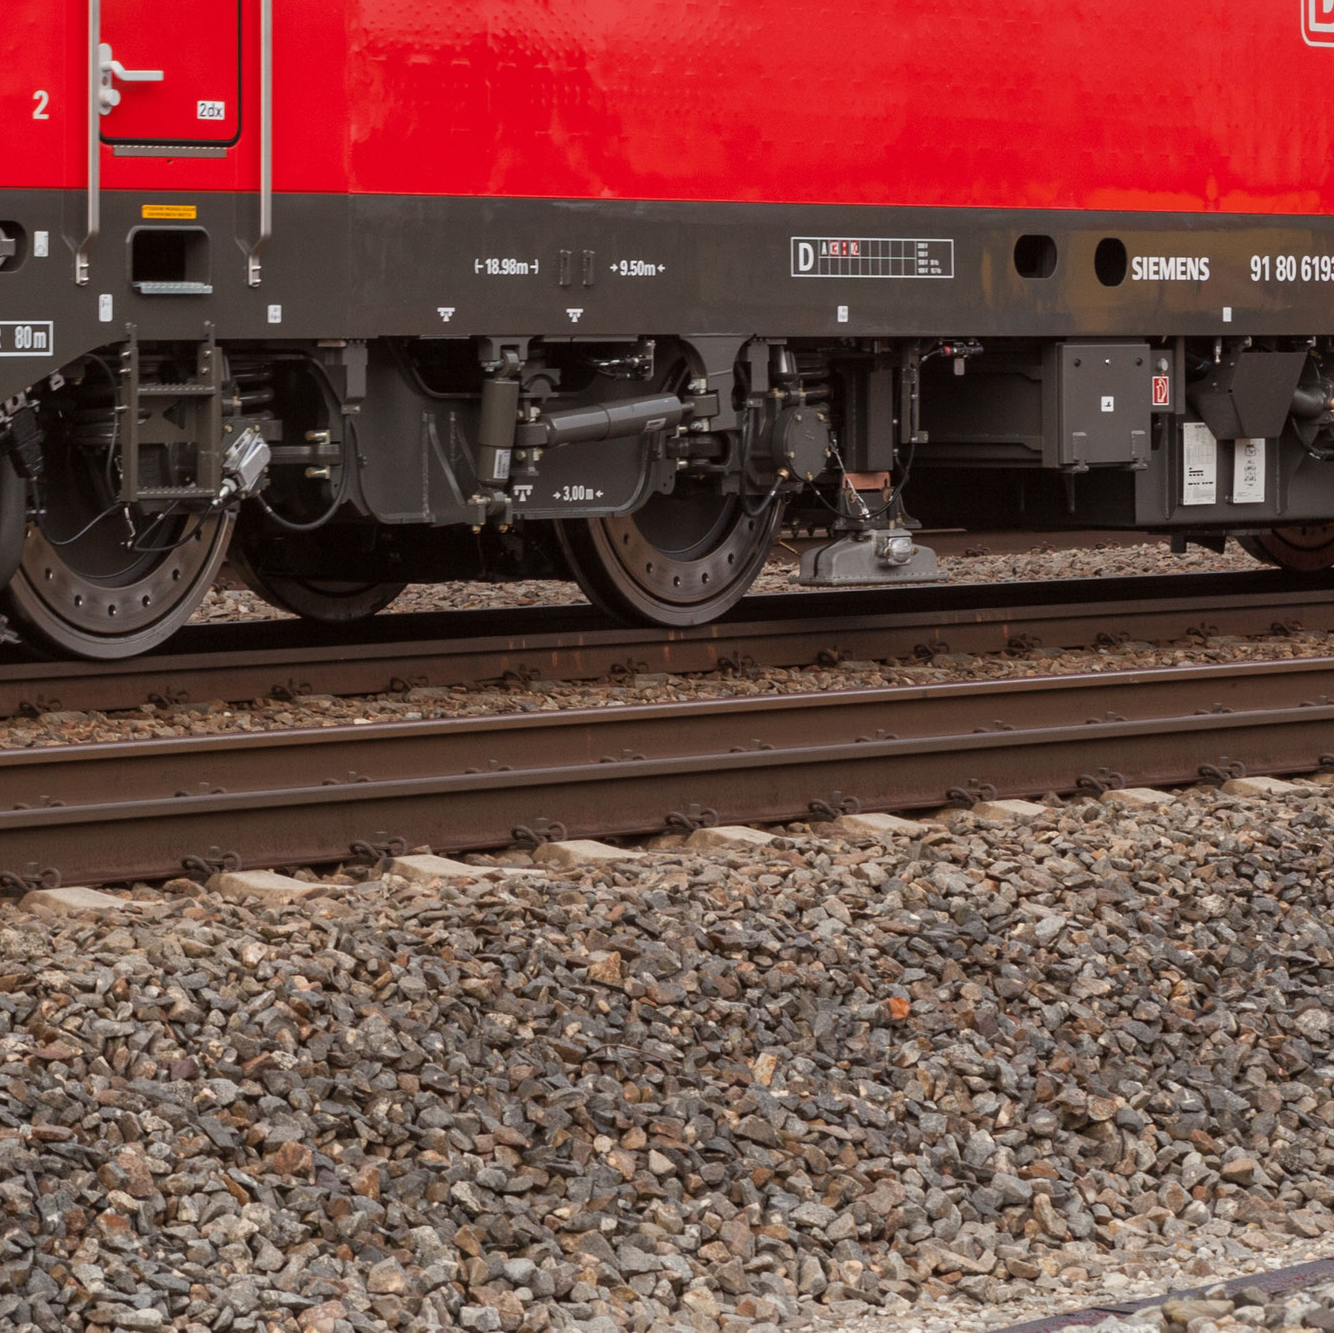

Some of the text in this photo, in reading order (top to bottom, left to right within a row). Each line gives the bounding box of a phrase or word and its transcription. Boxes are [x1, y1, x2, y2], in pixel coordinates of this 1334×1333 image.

[32, 90, 49, 119] 2
[198, 102, 223, 118] 2dx
[619, 260, 656, 276] 9.50m
[798, 242, 814, 272] D
[1131, 256, 1210, 281] SIEMENS
[1250, 255, 1270, 282] 91
[1275, 256, 1297, 282] 80
[15, 326, 32, 349] 80
